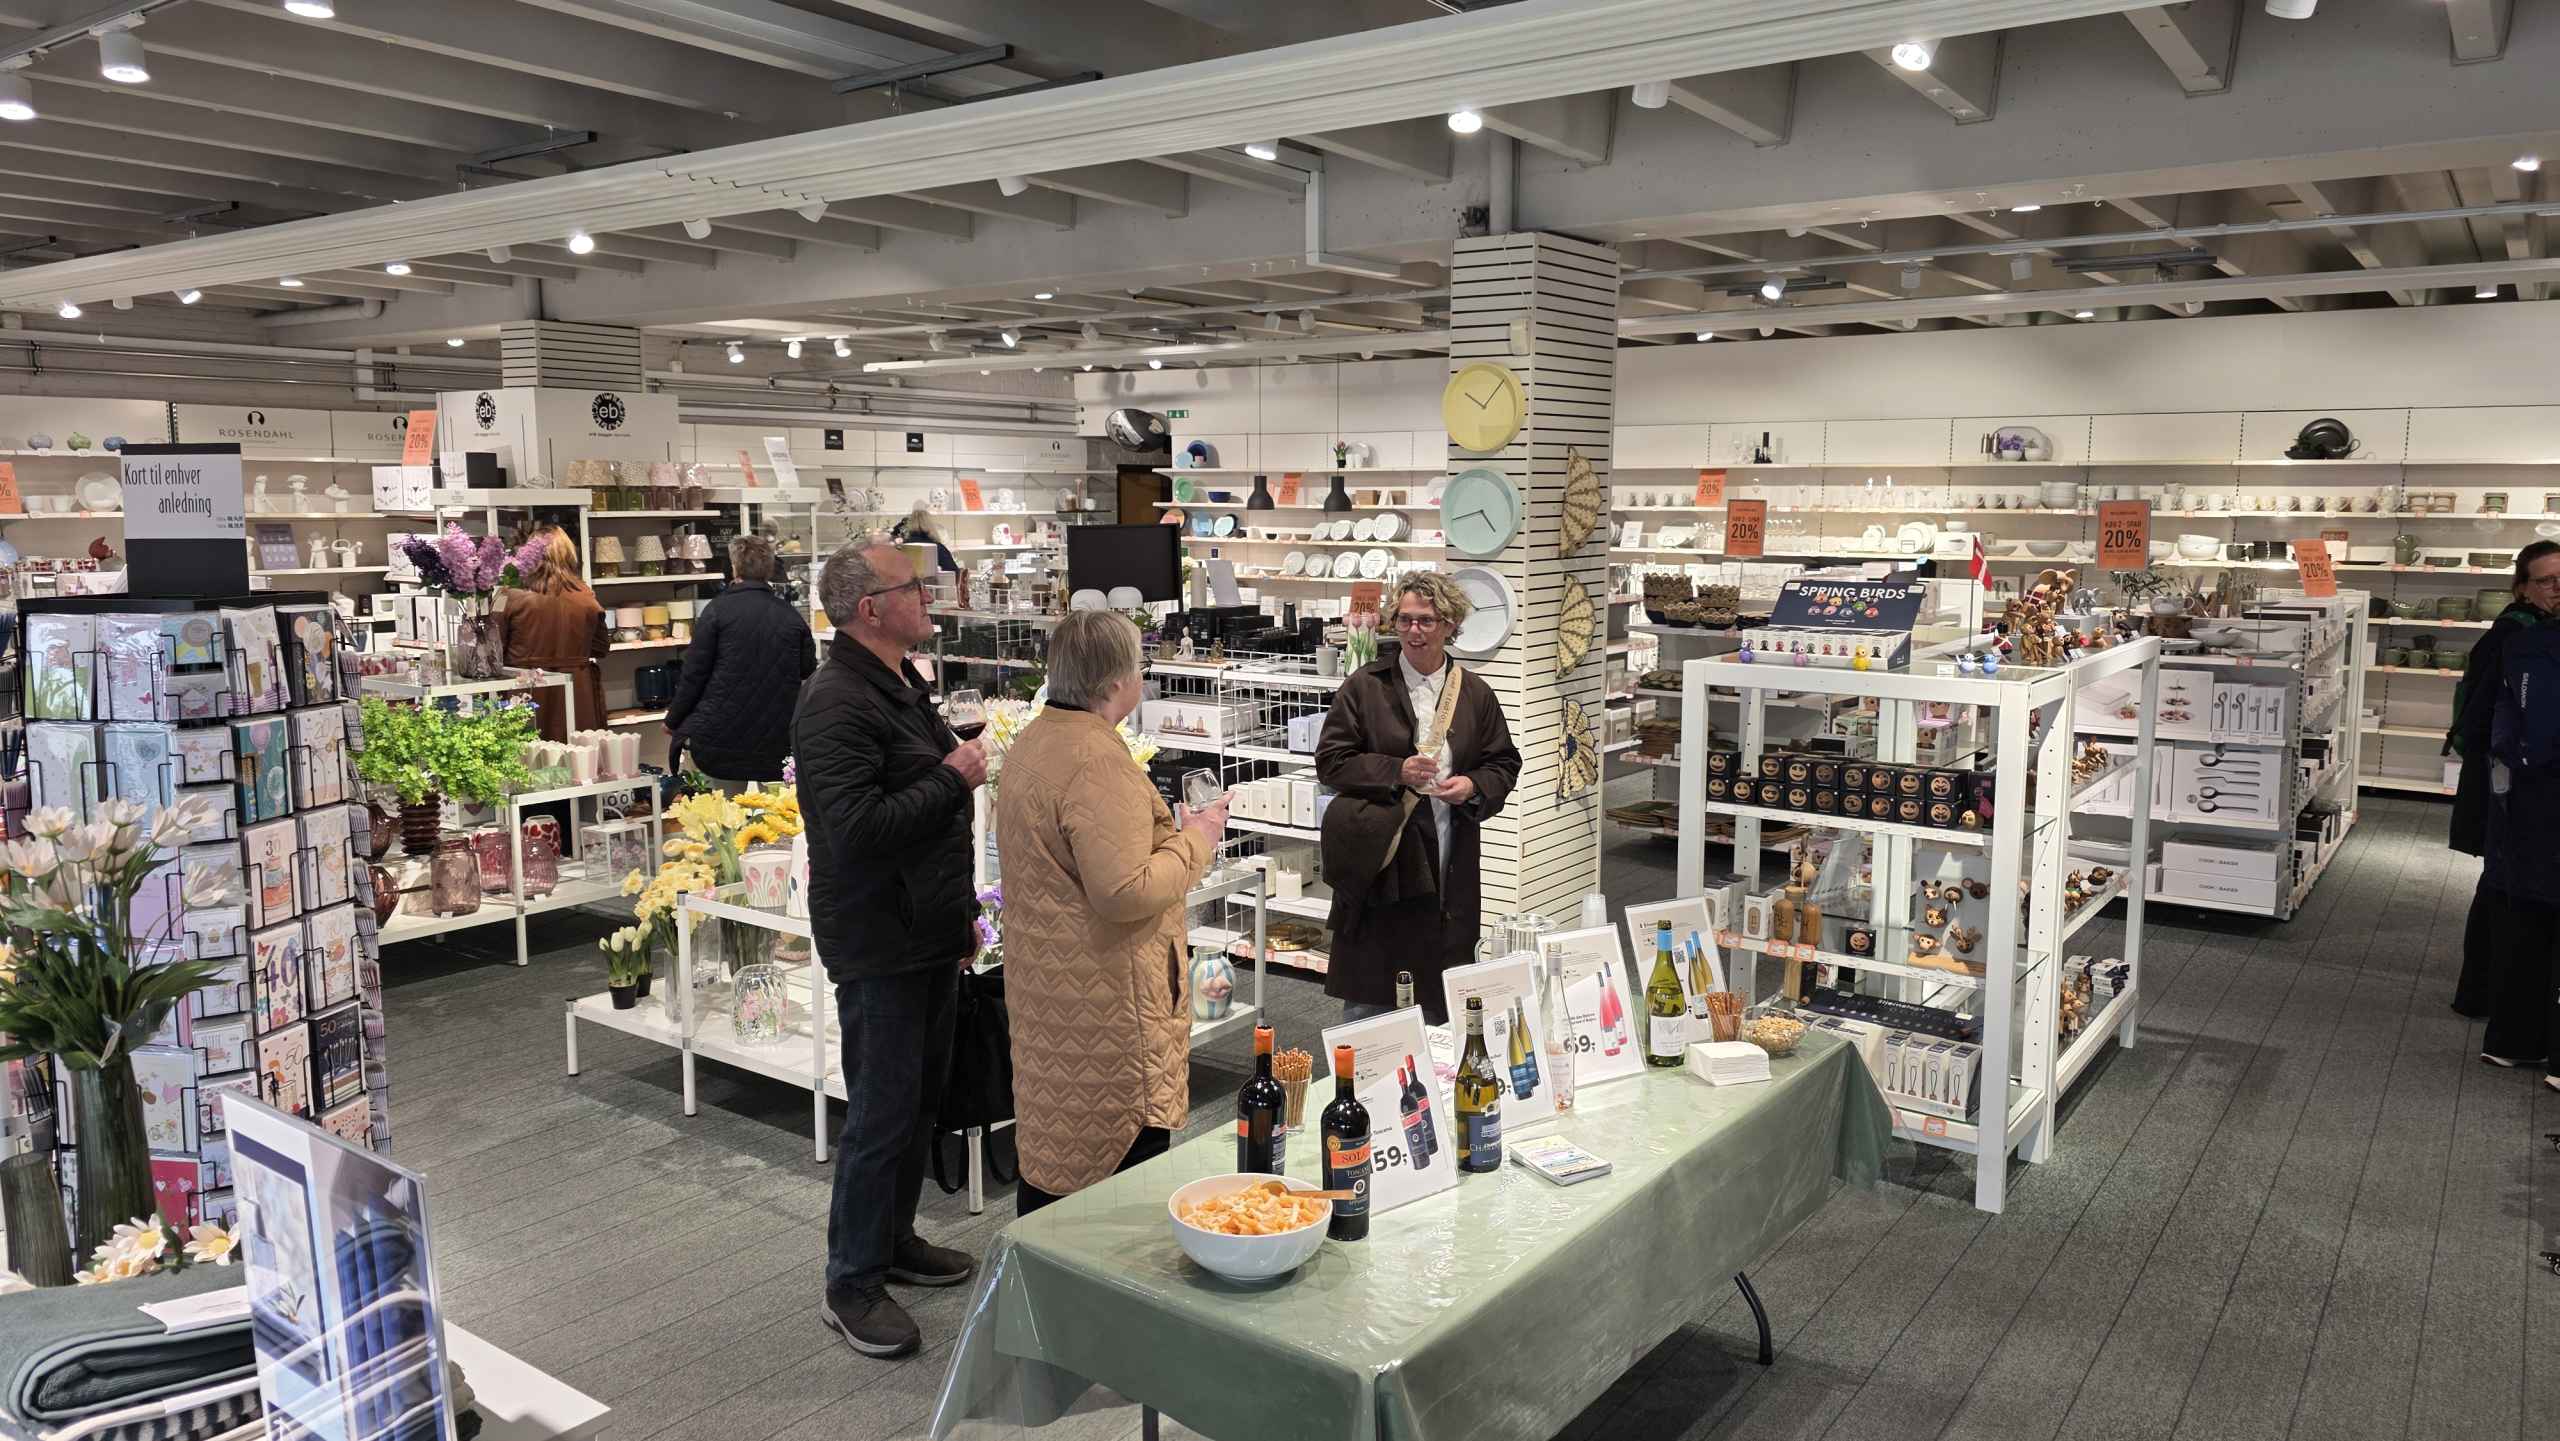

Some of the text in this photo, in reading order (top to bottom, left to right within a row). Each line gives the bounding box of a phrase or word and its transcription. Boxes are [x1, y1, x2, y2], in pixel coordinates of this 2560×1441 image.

[598, 403, 619, 420] eb
[218, 428, 296, 440] ROSENDAHL
[367, 431, 406, 442] ROSEN
[408, 432, 430, 449] 20%
[124, 462, 201, 486] Kort til enhver
[158, 492, 212, 518] anledning
[1731, 523, 1760, 540] 20%
[2104, 529, 2142, 548] 20%
[2303, 562, 2329, 578] 20%
[1799, 586, 1907, 600] SPRING BIRDS
[264, 944, 298, 993] 40
[319, 1019, 337, 1038] 50
[285, 1044, 304, 1070] 50
